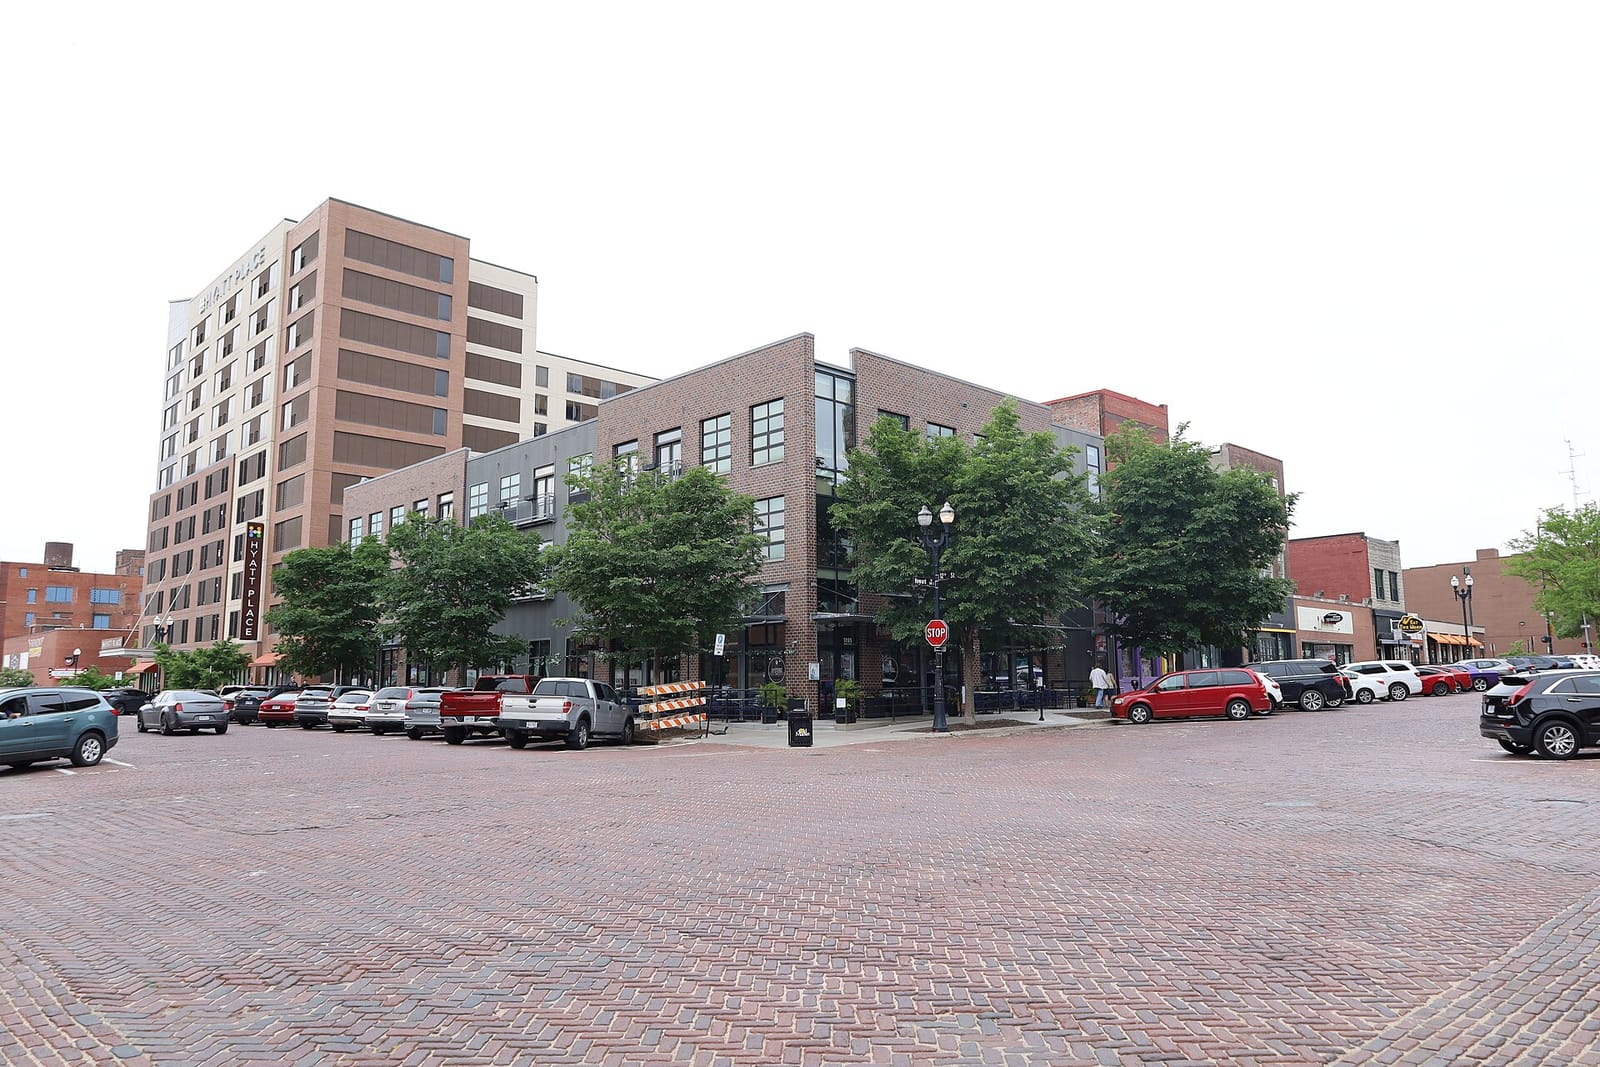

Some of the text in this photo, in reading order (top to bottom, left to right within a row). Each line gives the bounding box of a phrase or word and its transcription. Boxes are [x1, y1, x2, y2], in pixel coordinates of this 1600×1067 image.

[235, 246, 266, 286] PLACE
[245, 541, 258, 636] HYATT PLACE
[927, 627, 946, 638] STOP
